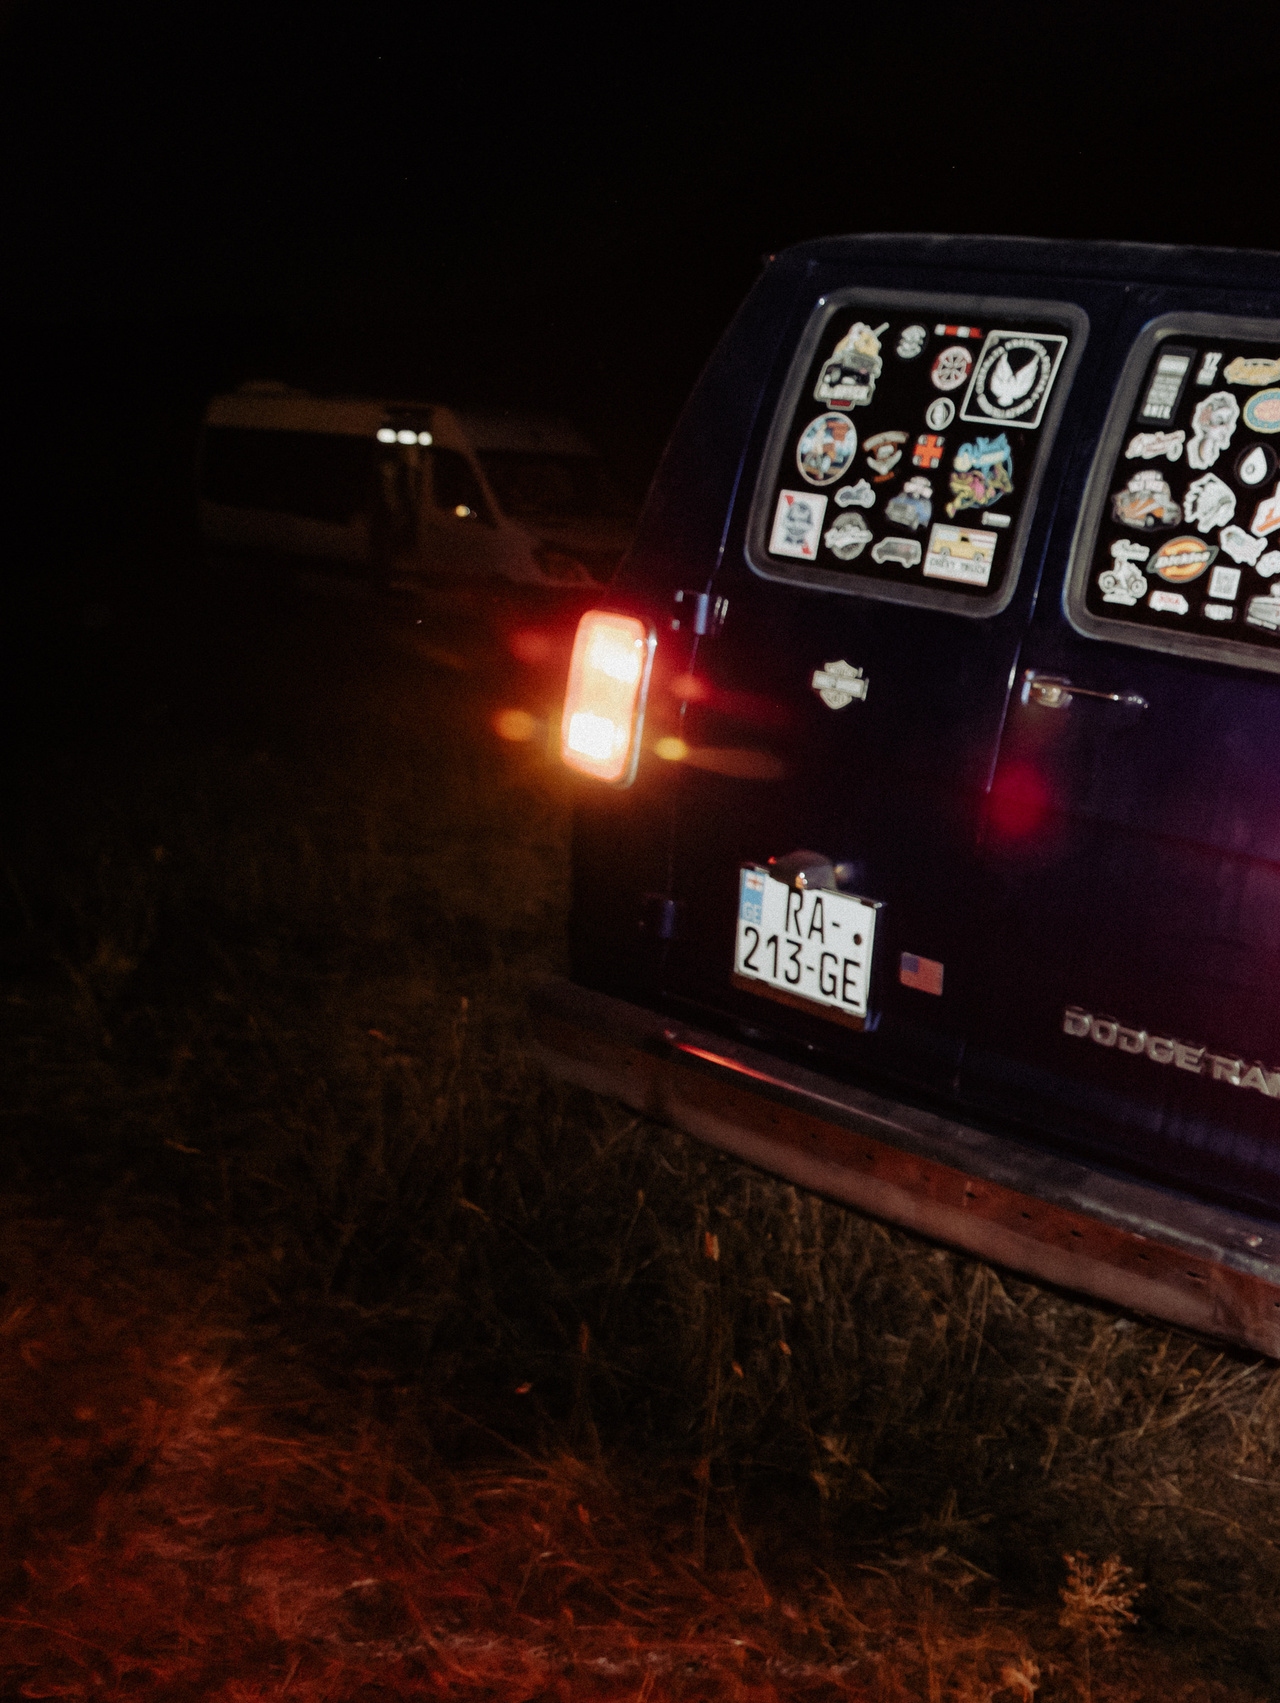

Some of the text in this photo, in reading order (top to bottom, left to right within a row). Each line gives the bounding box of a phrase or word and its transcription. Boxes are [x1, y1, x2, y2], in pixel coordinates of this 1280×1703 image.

[784, 889, 841, 944] RA-
[743, 926, 861, 1006] 213-GE
[1063, 1008, 1206, 1074] DODGE
